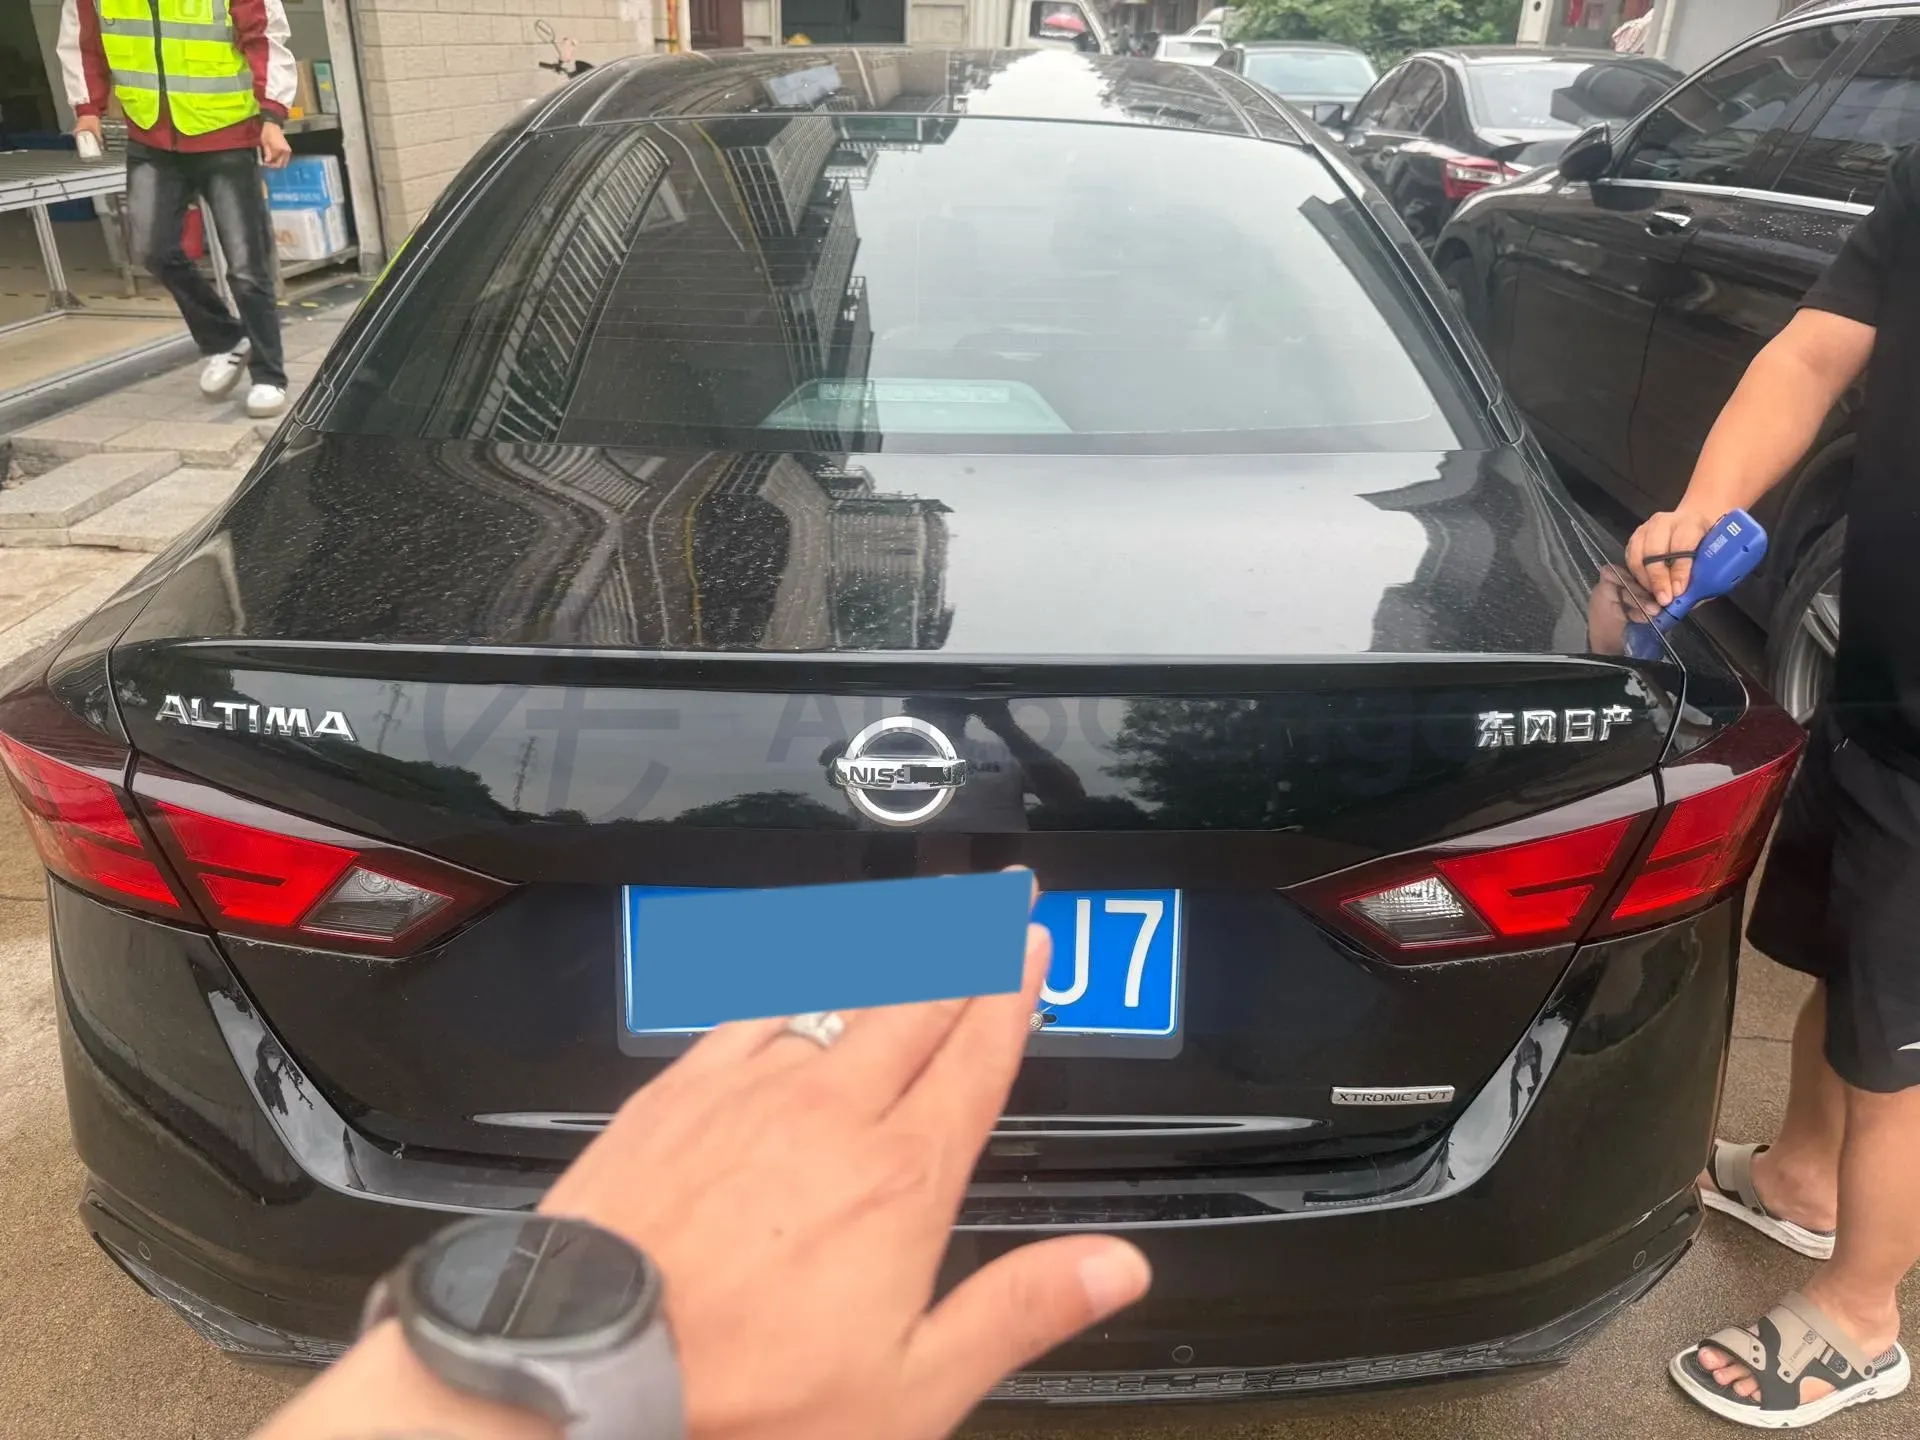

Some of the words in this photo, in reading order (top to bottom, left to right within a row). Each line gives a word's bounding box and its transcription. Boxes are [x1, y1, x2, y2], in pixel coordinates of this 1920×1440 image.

[155, 694, 358, 742] ALTIMA
[1475, 703, 1633, 748] 东风日产
[849, 764, 952, 785] NISS
[1338, 1092, 1413, 1103] XTRONIC
[1415, 1090, 1450, 1101] CVT
